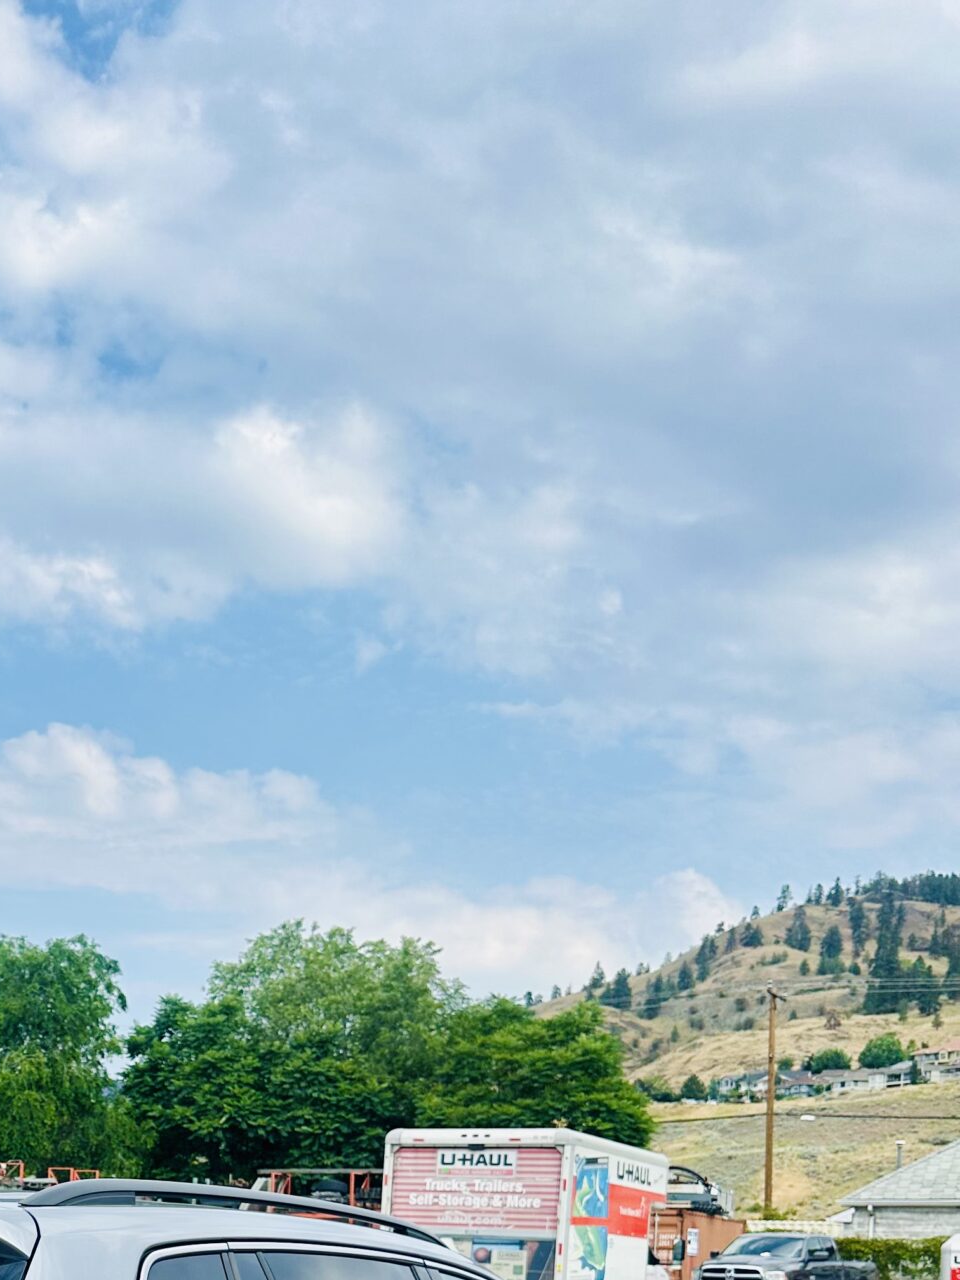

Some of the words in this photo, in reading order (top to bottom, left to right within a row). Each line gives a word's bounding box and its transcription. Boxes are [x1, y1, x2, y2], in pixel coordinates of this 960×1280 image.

[441, 1153, 513, 1166] U-HAUL
[617, 1161, 651, 1186] U-HAUL
[473, 1180, 526, 1194] Trailers,
[409, 1193, 490, 1209] Self-Storage
[493, 1195, 502, 1207] &
[506, 1195, 542, 1208] More
